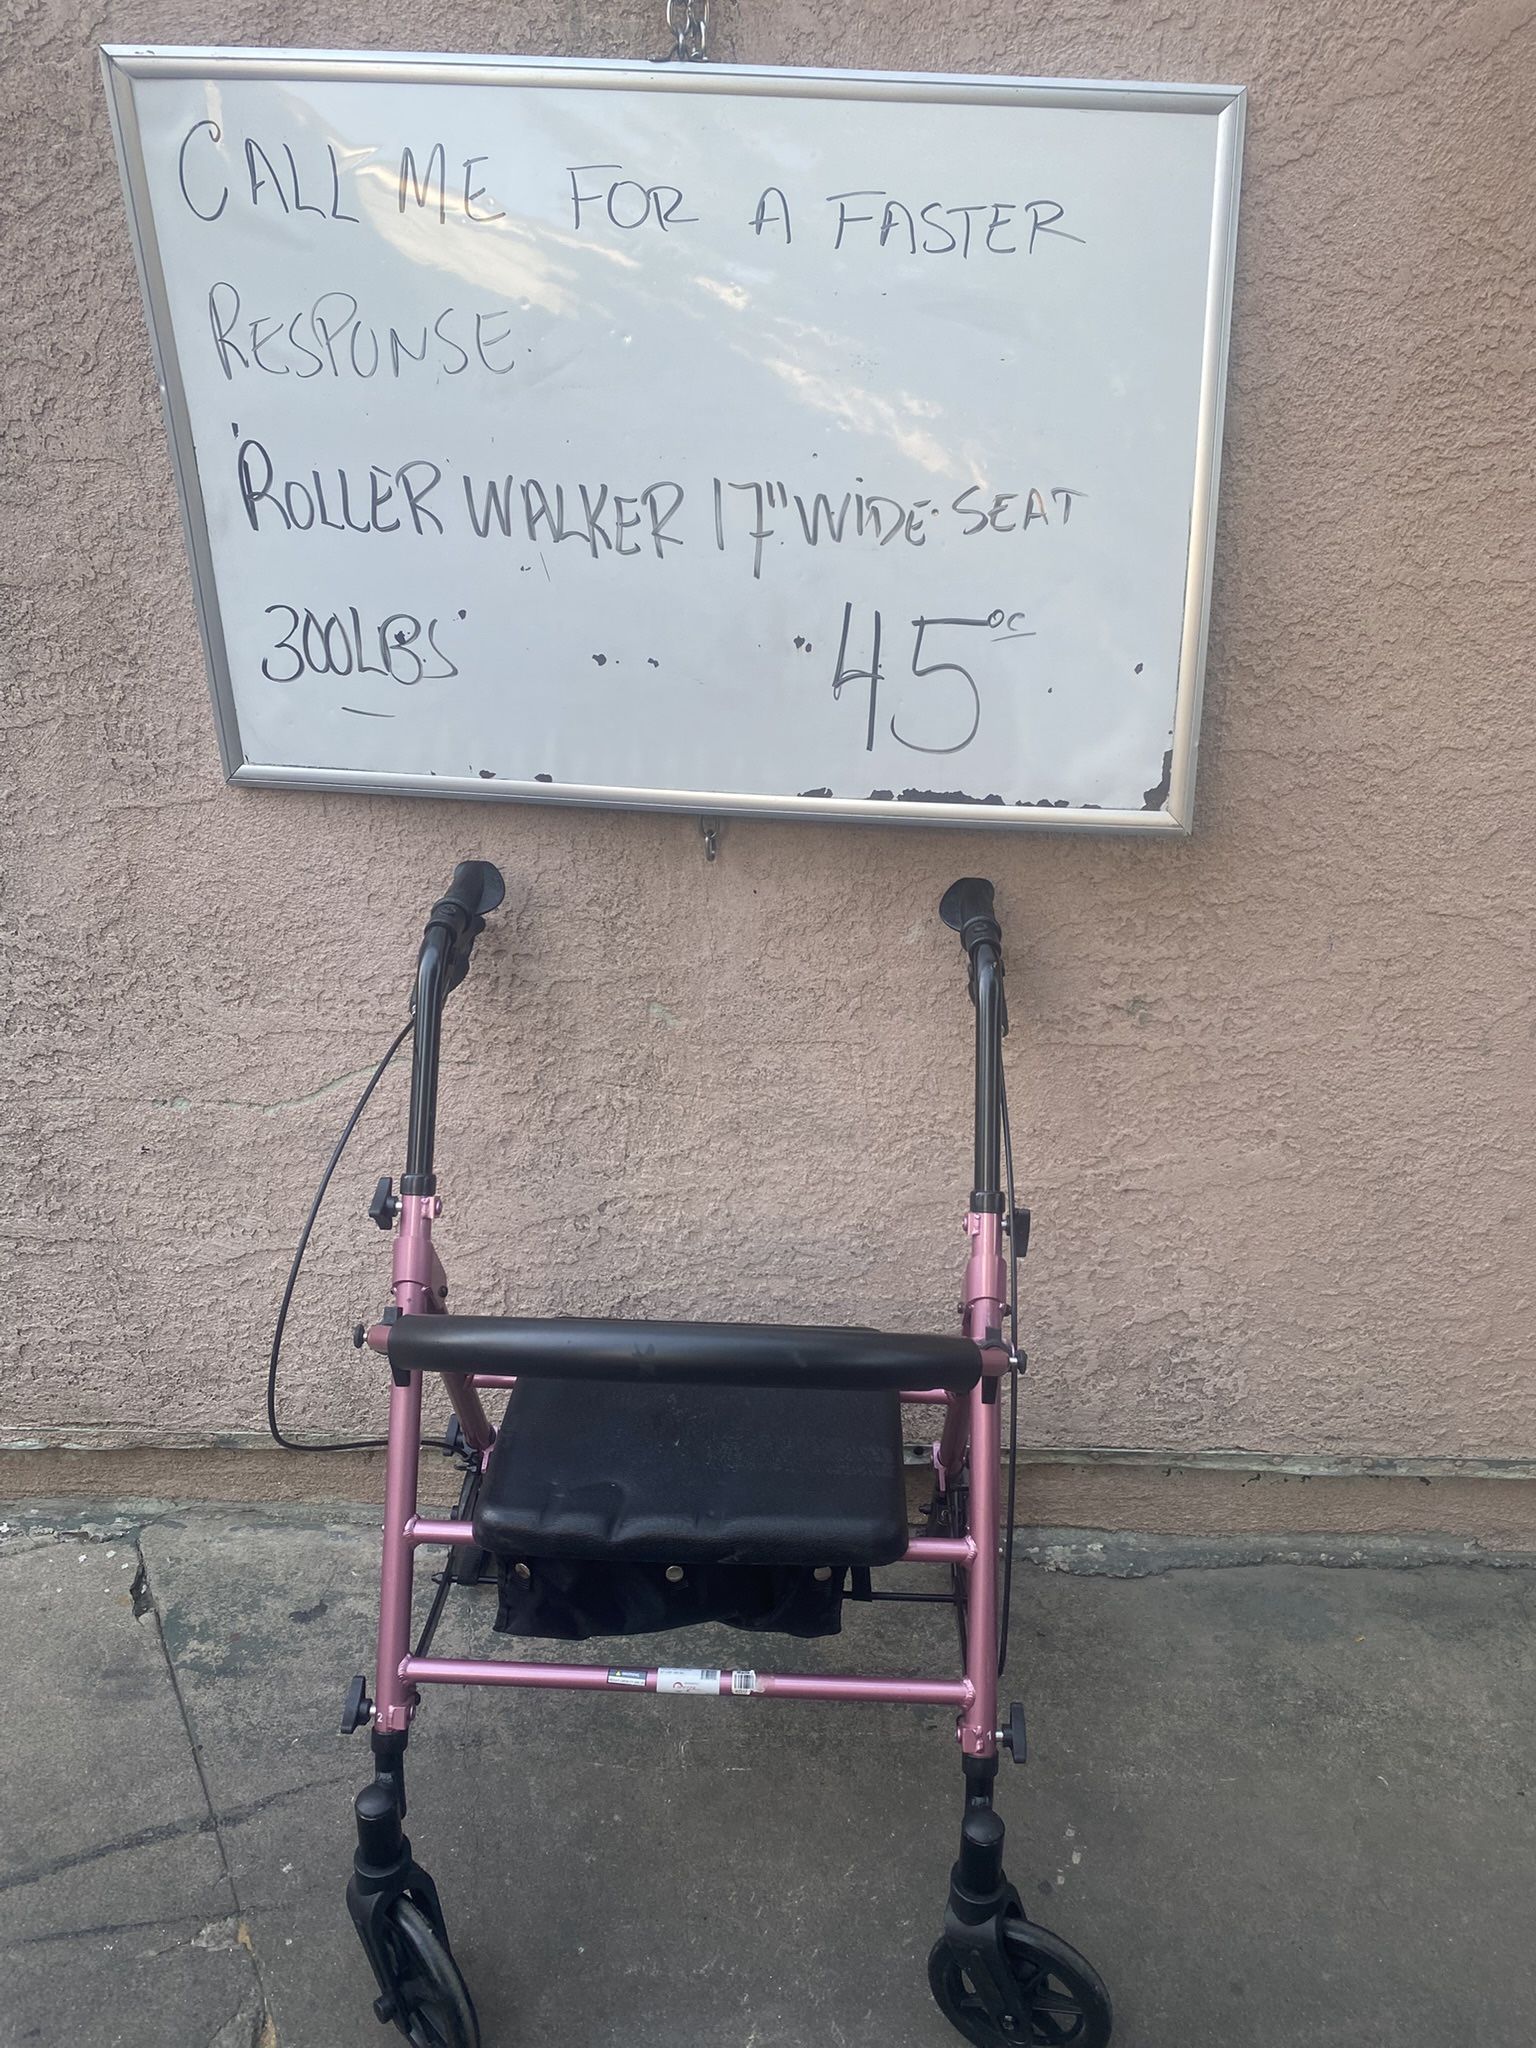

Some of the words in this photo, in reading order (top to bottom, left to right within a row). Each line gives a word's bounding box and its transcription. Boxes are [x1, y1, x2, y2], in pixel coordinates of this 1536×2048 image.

[179, 119, 360, 223] CALL
[399, 142, 507, 225] ME
[565, 163, 700, 232] FOR
[747, 185, 792, 245] A
[826, 189, 1087, 260] FASTER
[237, 439, 444, 536] ROLLER
[462, 472, 686, 559] WALKER
[951, 484, 1089, 536] SEAT
[377, 1712, 383, 1722] 2
[986, 1730, 992, 1741] 1
